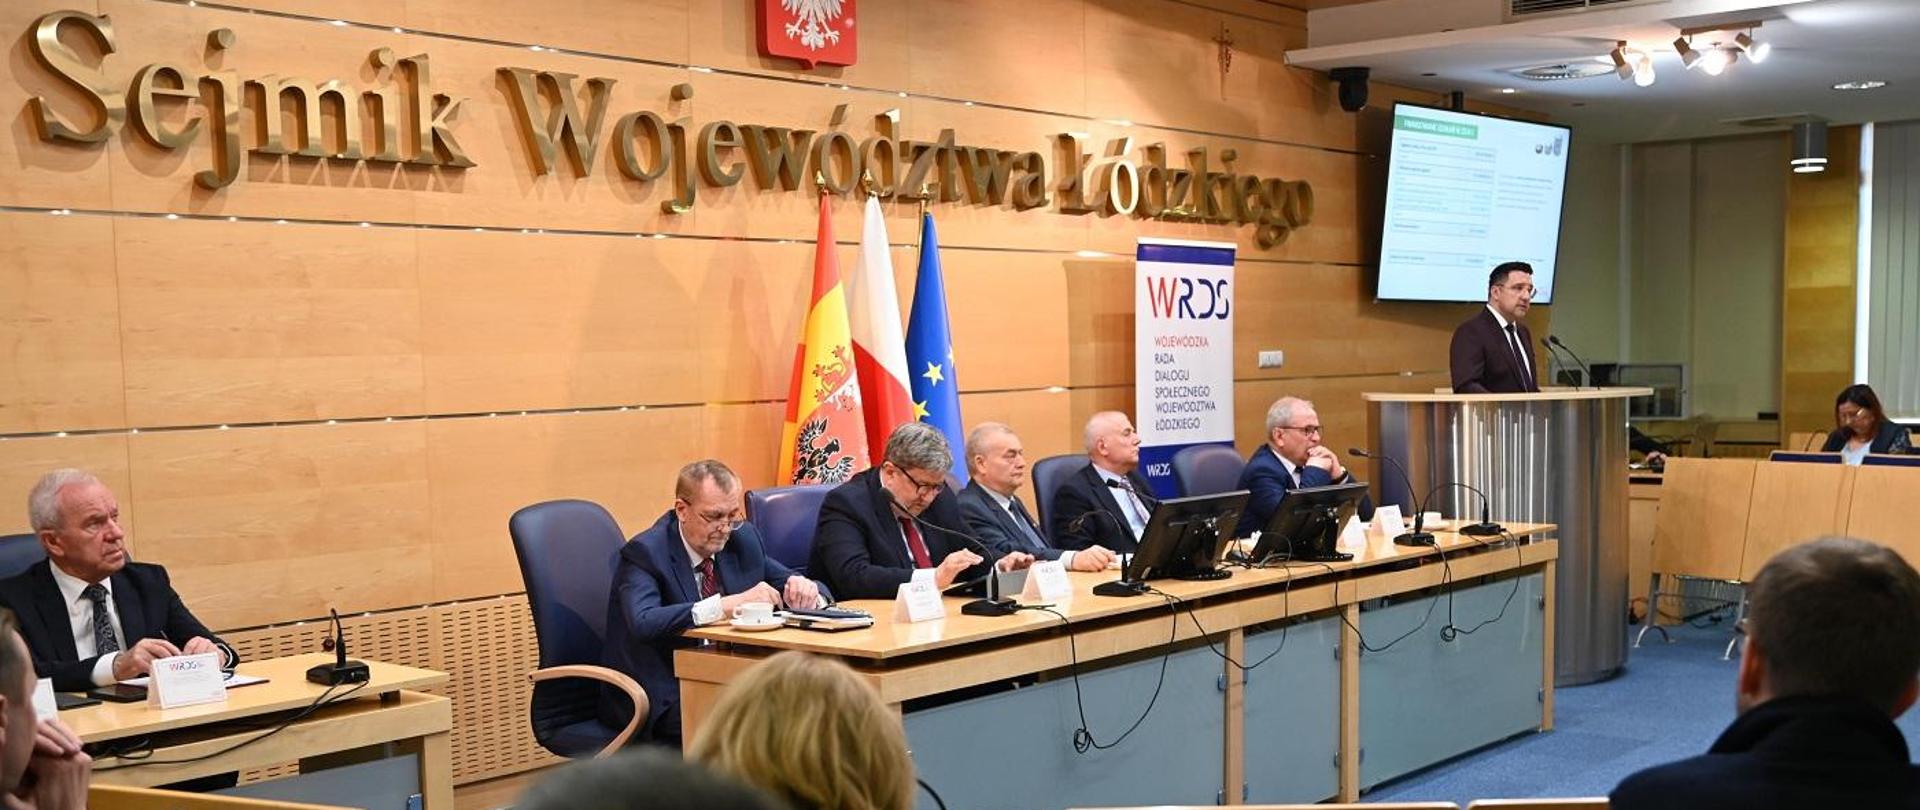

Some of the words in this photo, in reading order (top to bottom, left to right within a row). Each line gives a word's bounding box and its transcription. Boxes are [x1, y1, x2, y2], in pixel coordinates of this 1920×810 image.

[27, 10, 477, 190] Sejmik
[496, 67, 1050, 214] Województwa
[1046, 133, 1314, 250] Łódzkiego
[1147, 276, 1230, 320] WRDS
[1154, 353, 1175, 364] RADA
[1155, 369, 1190, 382] DIALOGU
[1155, 386, 1211, 399] SPOŁECZNEGO
